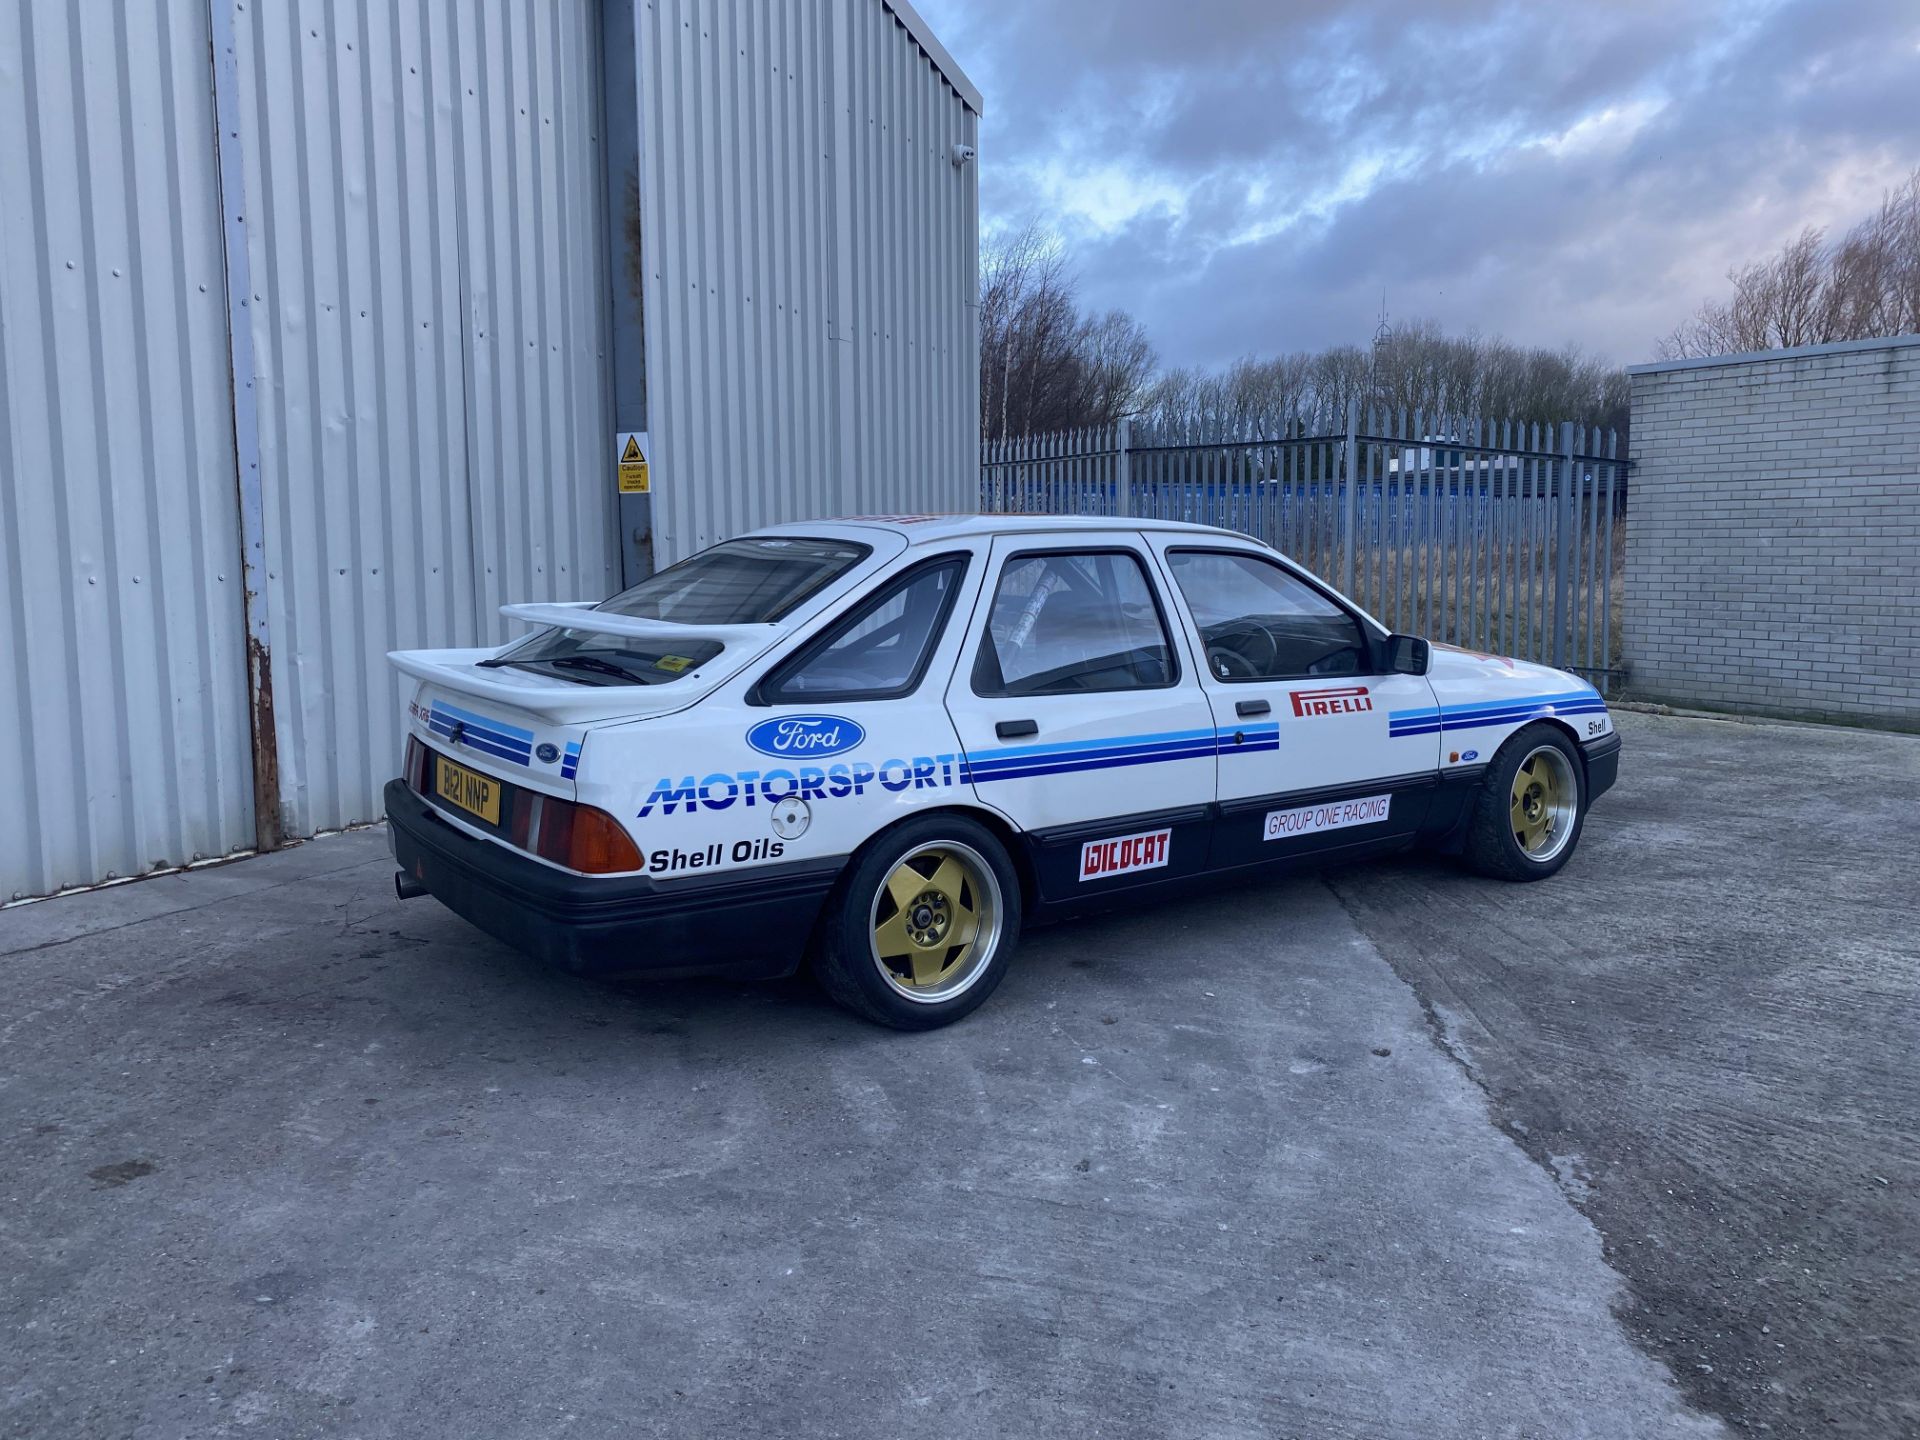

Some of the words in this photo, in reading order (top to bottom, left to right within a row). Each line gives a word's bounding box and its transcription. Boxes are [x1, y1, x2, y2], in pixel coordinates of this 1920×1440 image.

[621, 464, 645, 472] Caution
[1289, 686, 1373, 717] PIRELLI
[772, 720, 841, 751] Ford
[1588, 718, 1606, 736] Shell
[465, 774, 490, 815] NNP
[636, 753, 955, 818] MOTORSPORT
[1268, 810, 1313, 835] GROUP
[1315, 806, 1341, 827] ONE
[1342, 798, 1387, 823] RACING
[649, 843, 723, 873] Shell
[731, 837, 785, 863] Oils
[1083, 833, 1169, 875] WILDCAT
